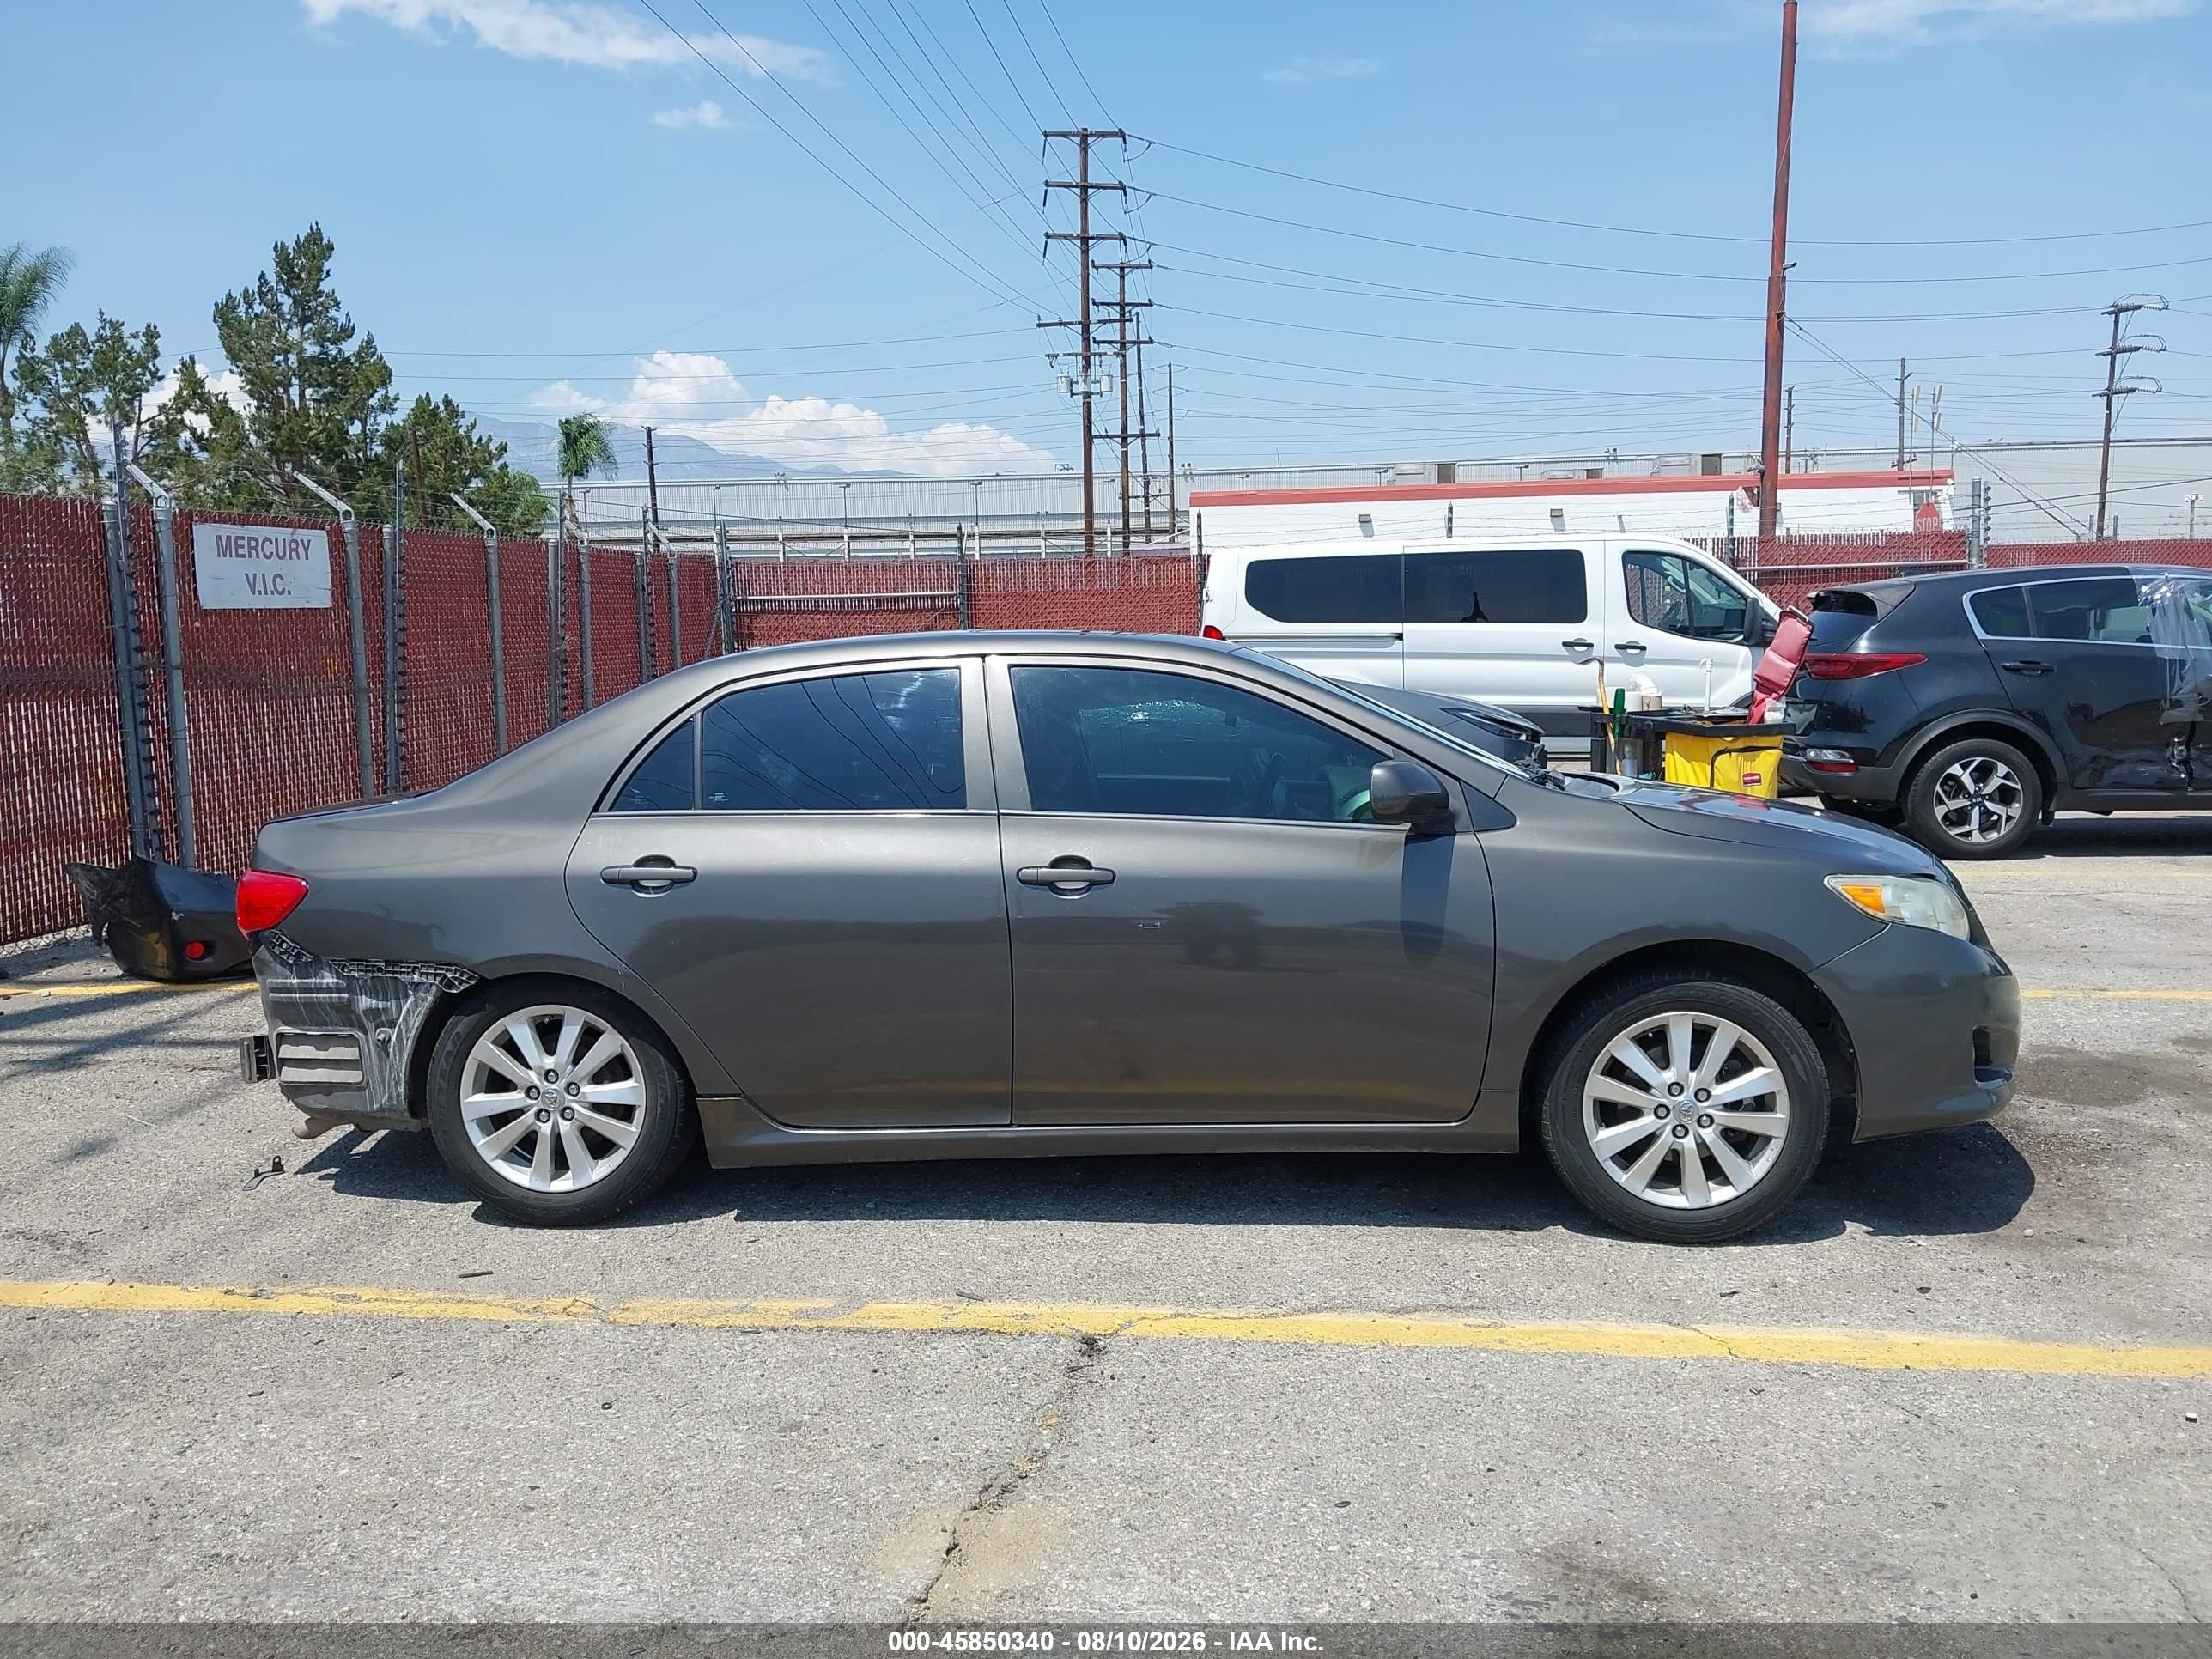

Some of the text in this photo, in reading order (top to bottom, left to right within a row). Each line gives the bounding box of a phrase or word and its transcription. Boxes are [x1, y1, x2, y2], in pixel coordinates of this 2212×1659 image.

[1917, 516, 1938, 532] STOP
[216, 535, 311, 560] MERCURY
[245, 573, 291, 595] V.I.C.
